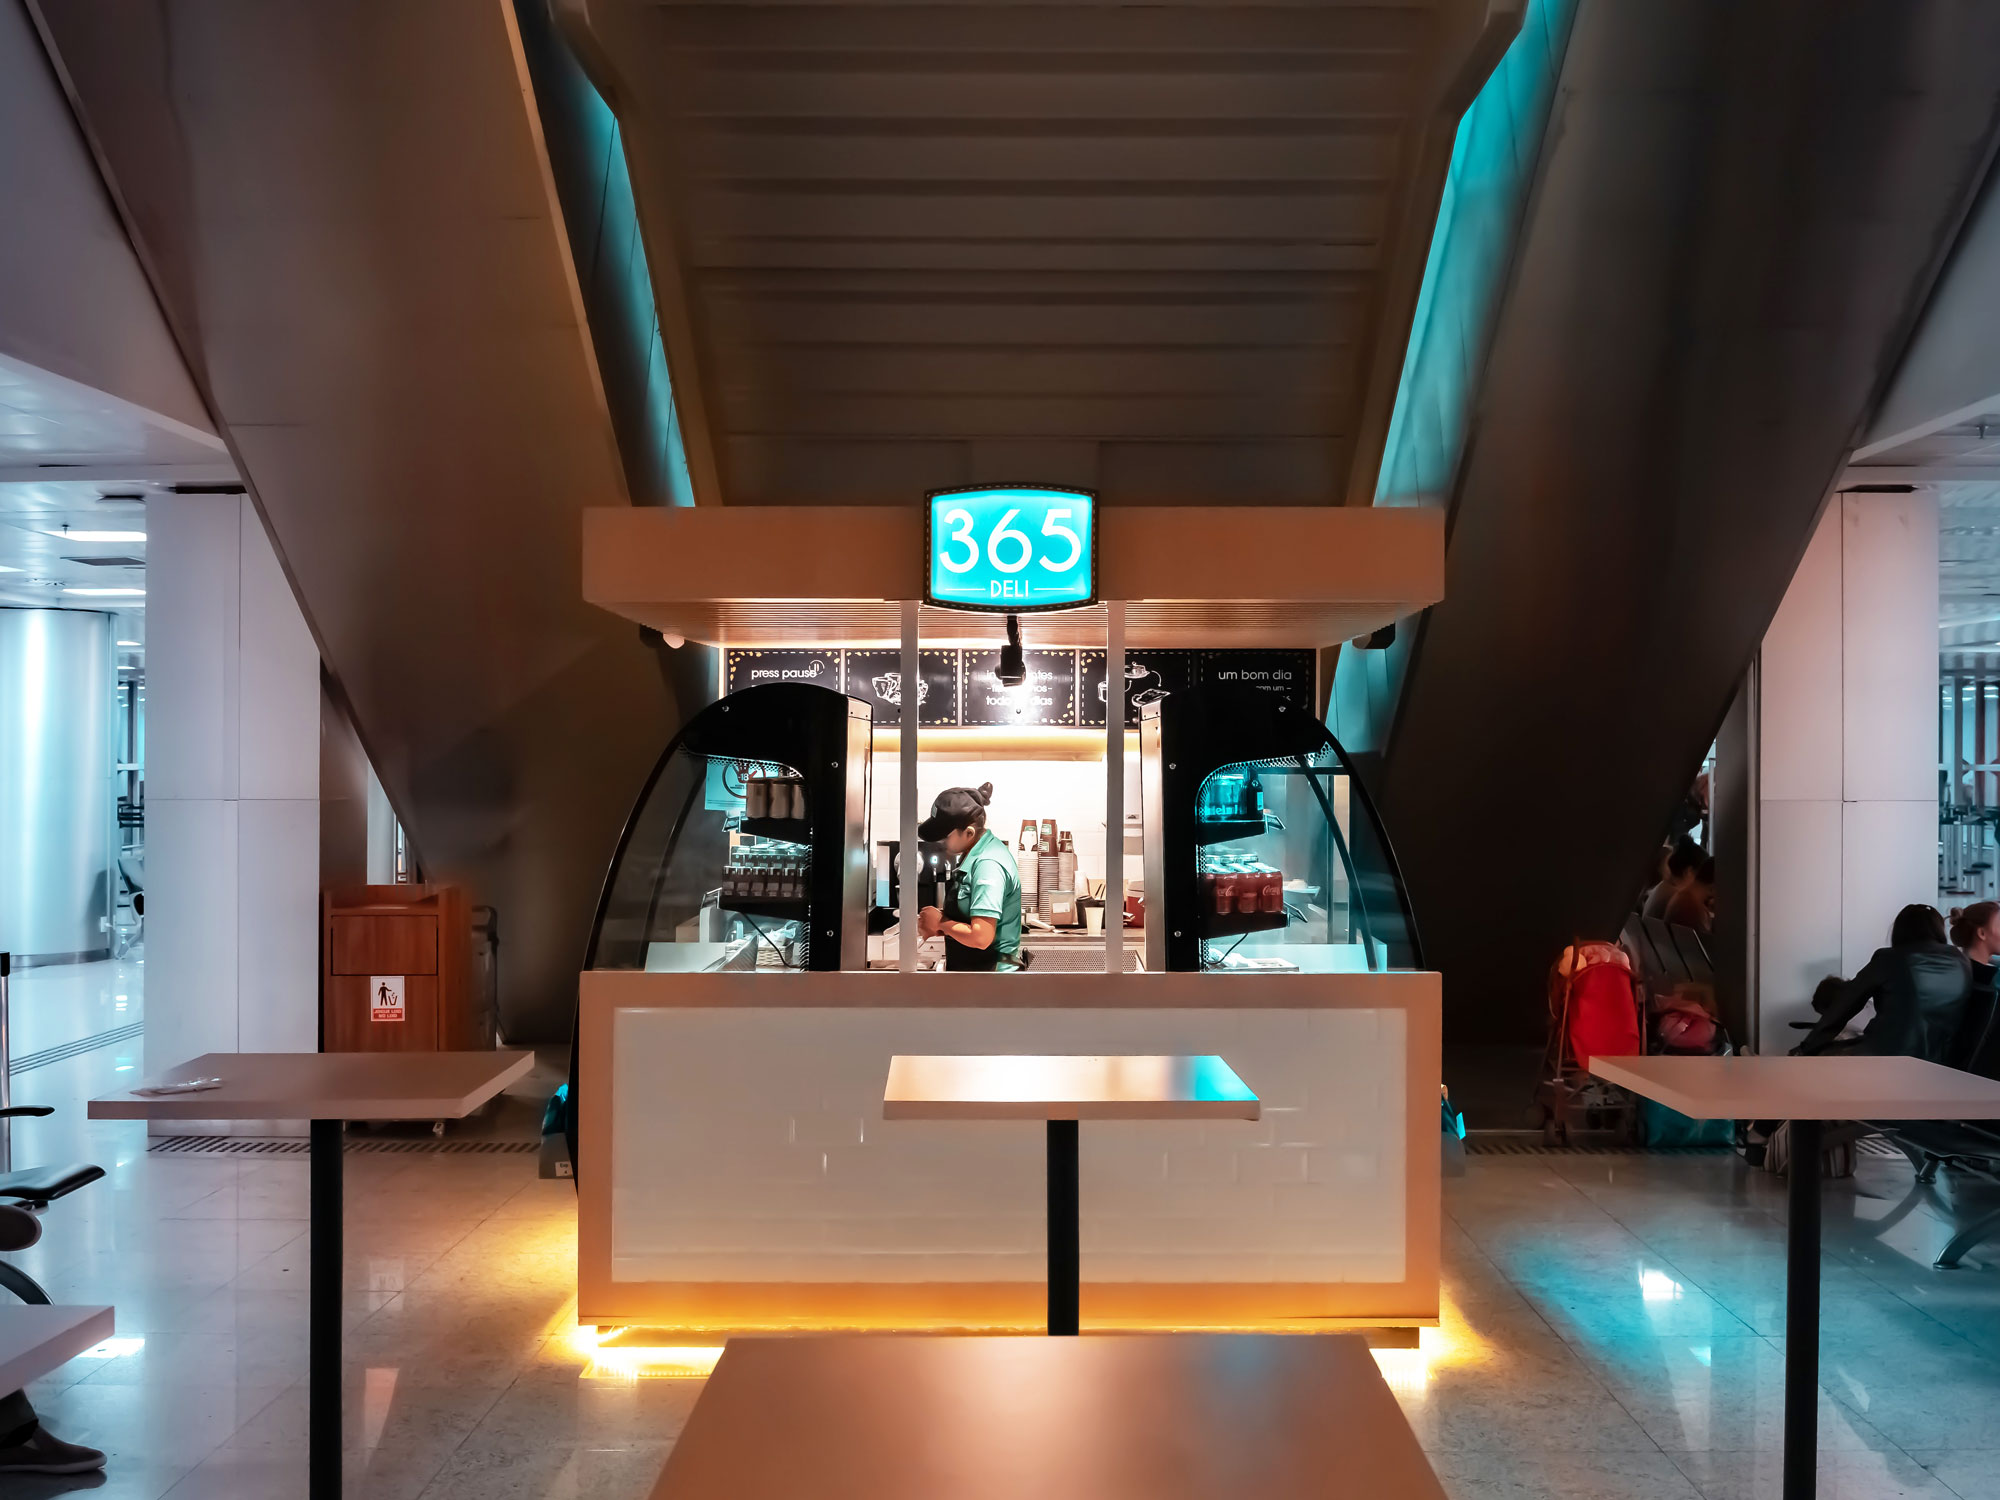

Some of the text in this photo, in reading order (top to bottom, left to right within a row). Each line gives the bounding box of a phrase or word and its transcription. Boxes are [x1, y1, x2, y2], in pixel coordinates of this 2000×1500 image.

[939, 508, 1081, 573] 365
[990, 580, 1028, 597] DELI
[751, 669, 817, 680] press pause
[1218, 668, 1292, 680] um bom dia
